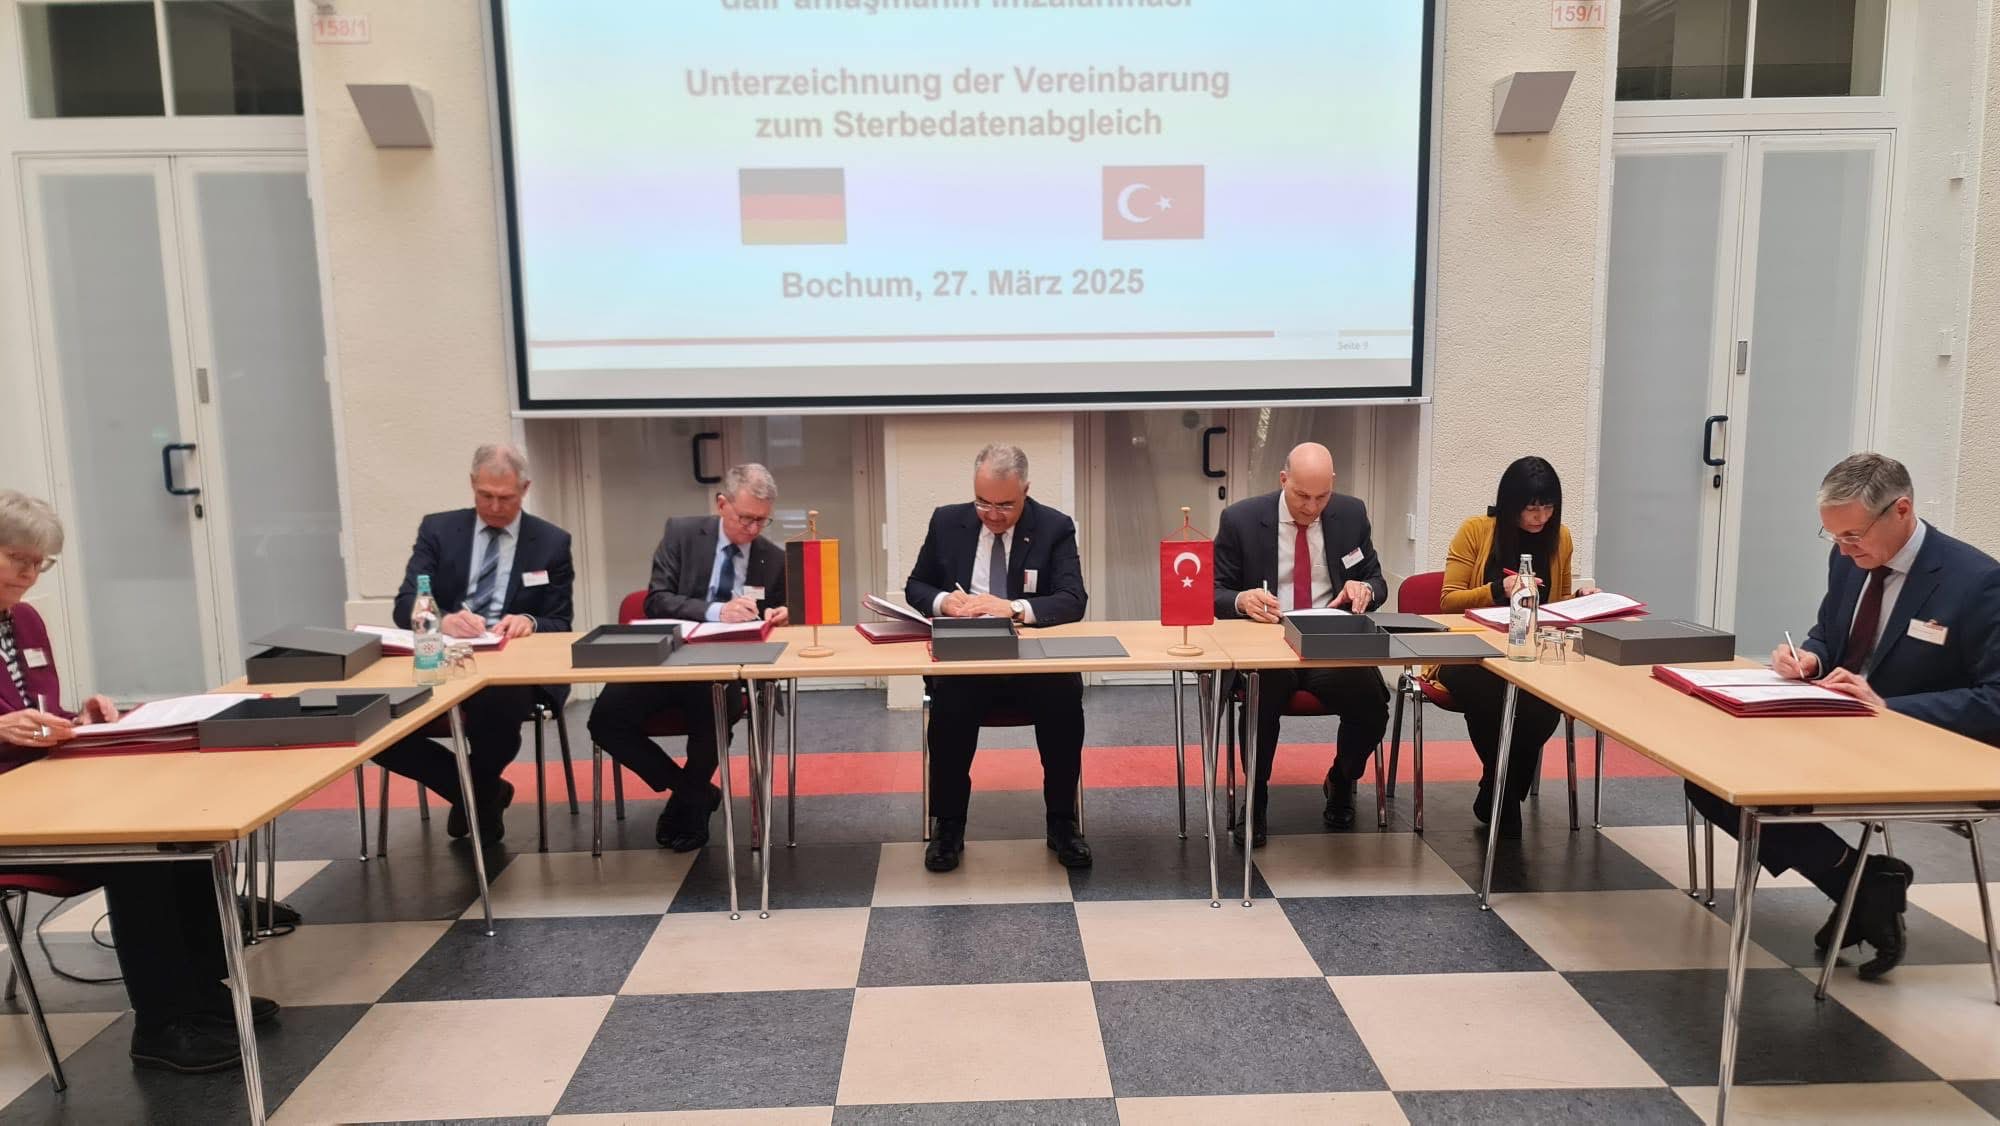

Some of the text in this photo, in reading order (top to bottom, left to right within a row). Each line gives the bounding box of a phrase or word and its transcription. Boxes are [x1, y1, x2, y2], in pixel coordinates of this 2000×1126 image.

[1554, 5, 1602, 22] 159/1
[685, 65, 1230, 101] Unterzeichnung der Vereinbarung
[755, 108, 1163, 143] zum Sterbedatenabgleich
[782, 268, 1144, 302] Bochum, 27. März 2025
